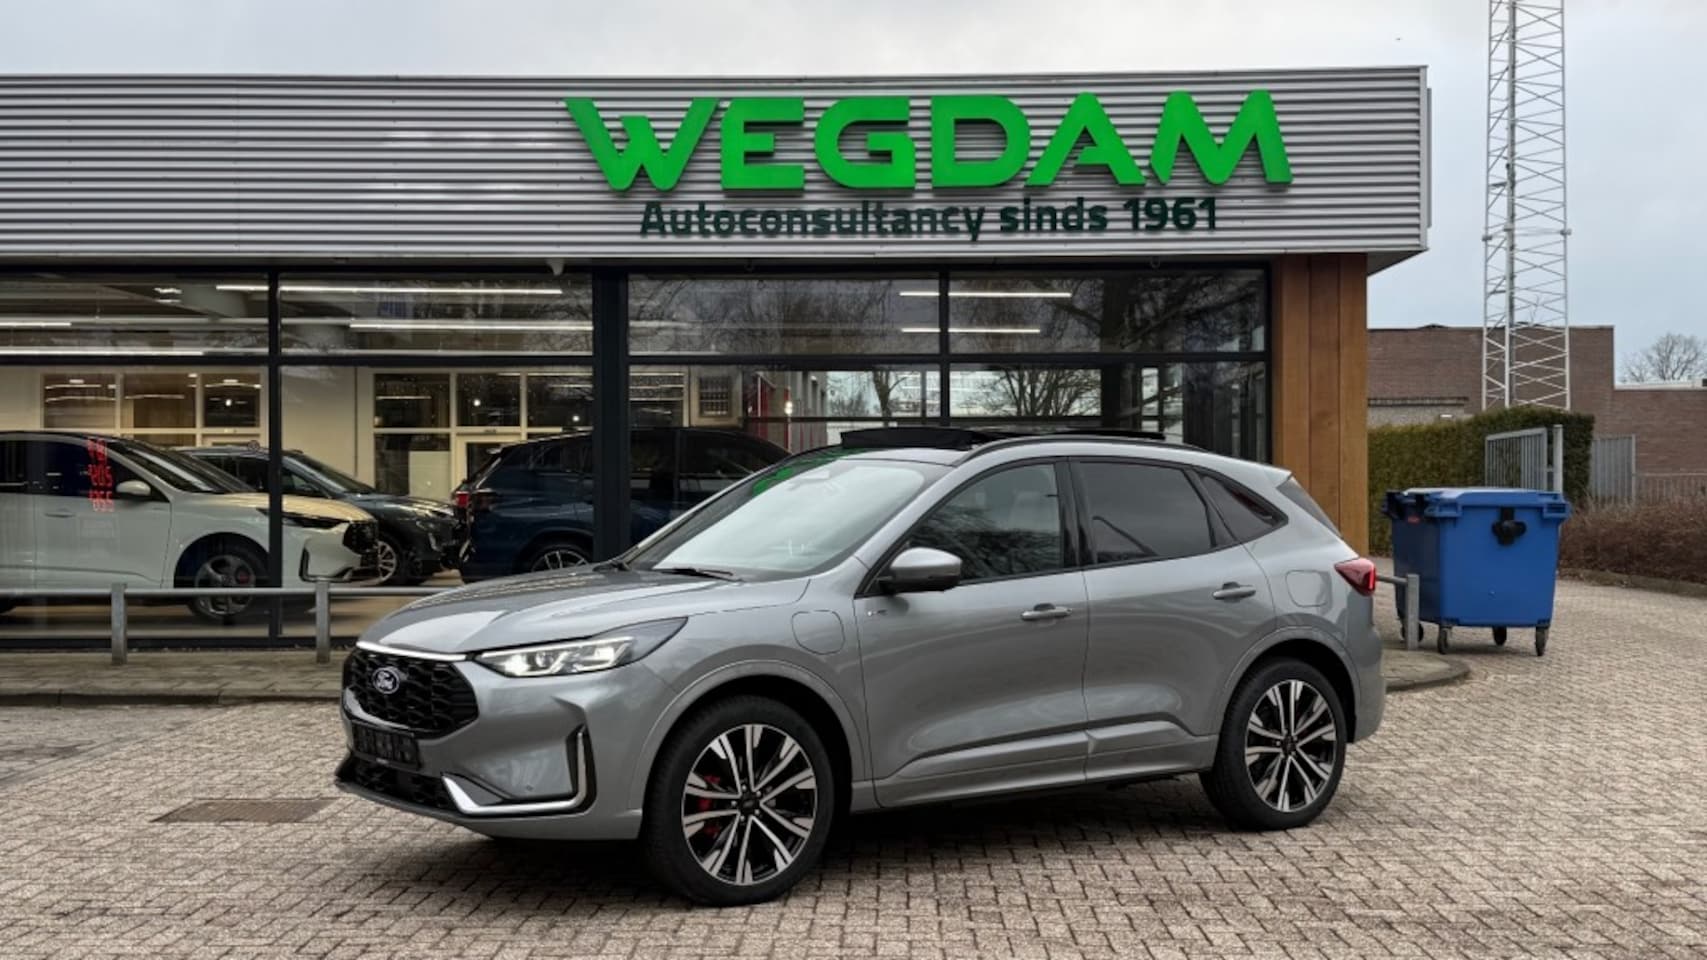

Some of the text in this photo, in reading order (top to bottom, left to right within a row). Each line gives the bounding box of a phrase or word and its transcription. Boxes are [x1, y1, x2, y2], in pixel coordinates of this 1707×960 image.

[565, 89, 1293, 191] WEGDAM
[640, 196, 1216, 242] Autoconsultancy sinds 1961
